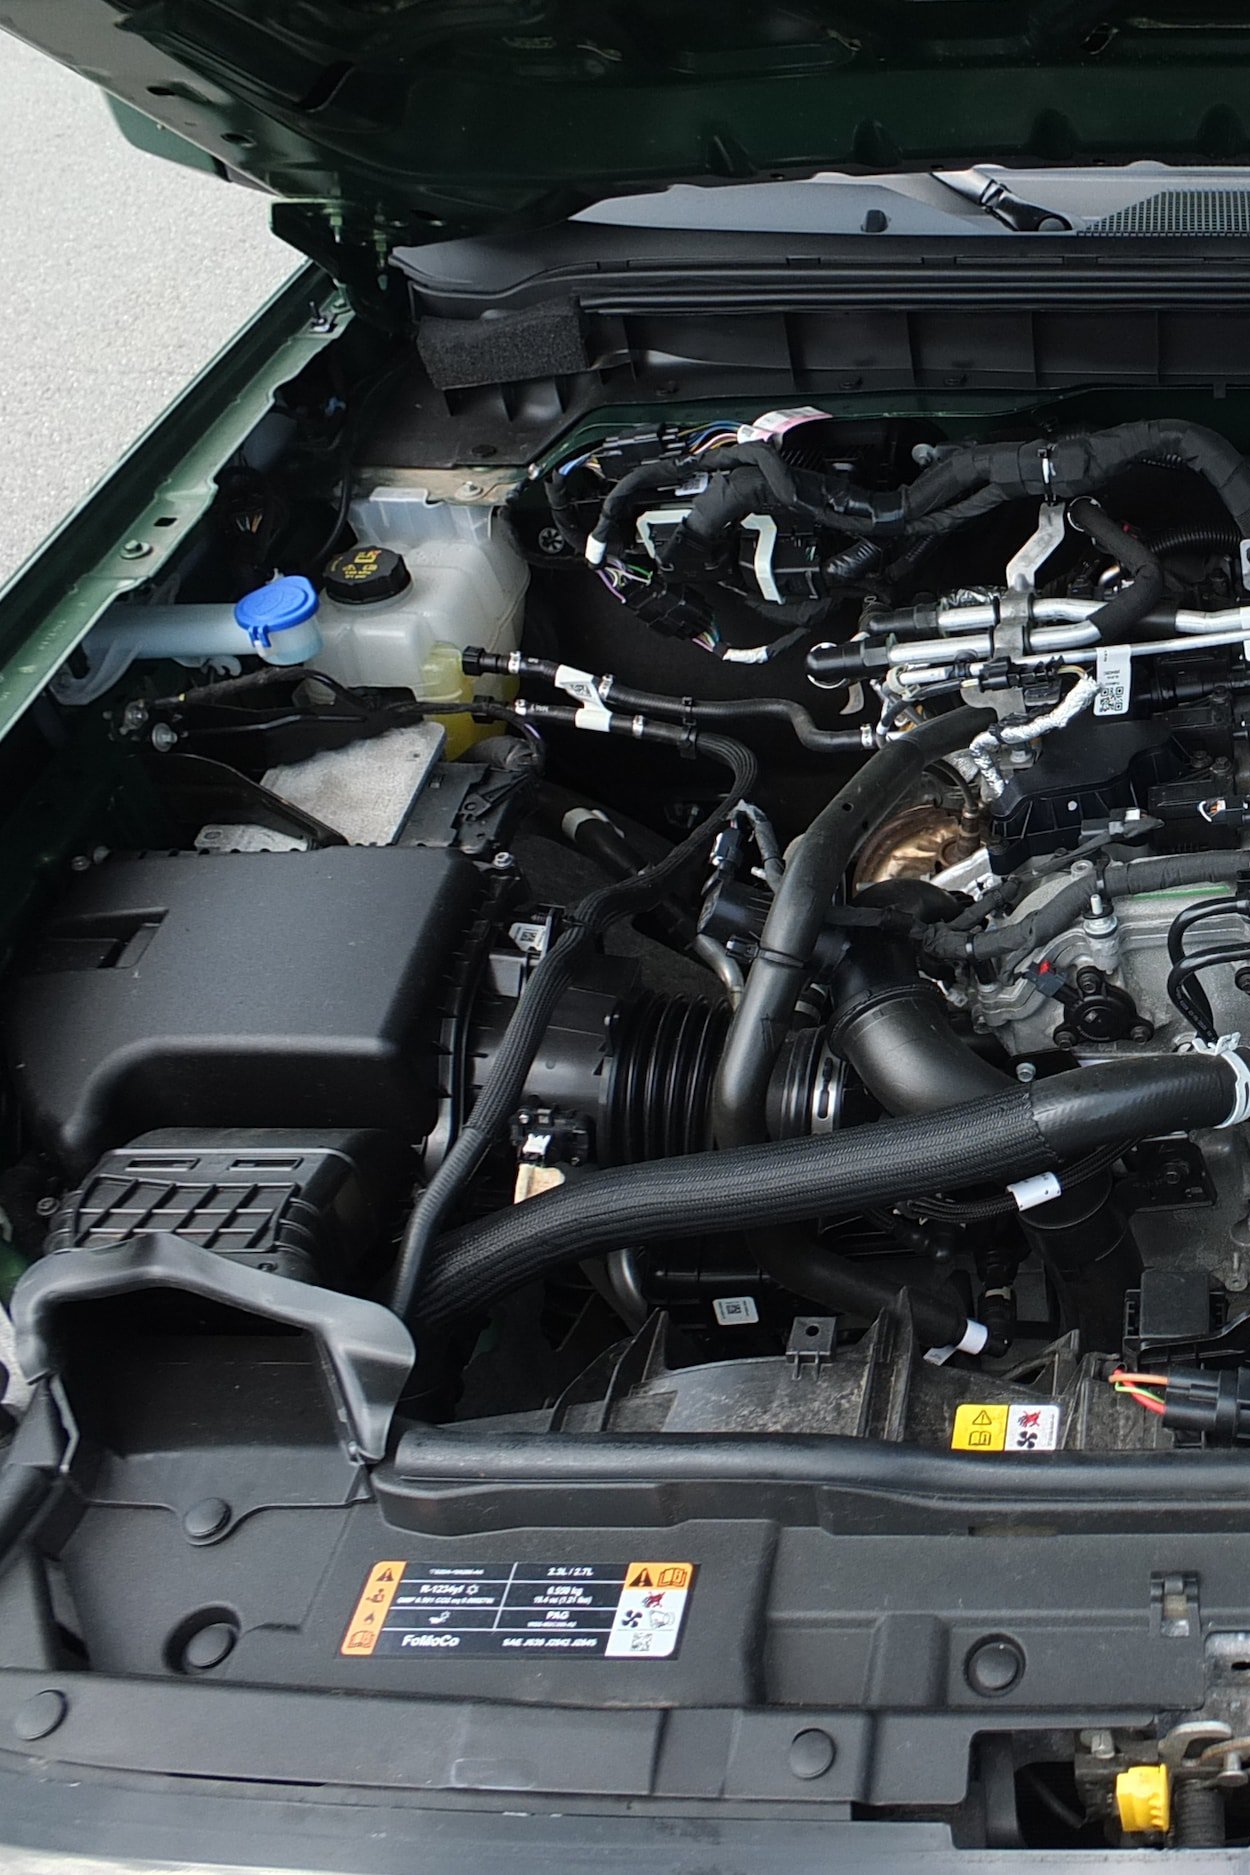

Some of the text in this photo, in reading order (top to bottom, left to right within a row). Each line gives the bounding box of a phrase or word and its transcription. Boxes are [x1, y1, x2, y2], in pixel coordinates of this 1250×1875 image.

[547, 1567, 567, 1576] 2.3L
[573, 1567, 594, 1576] 2.7L
[420, 1584, 465, 1595] R-1234yf
[546, 1611, 570, 1620] PAG
[401, 1634, 461, 1647] FoMoCo
